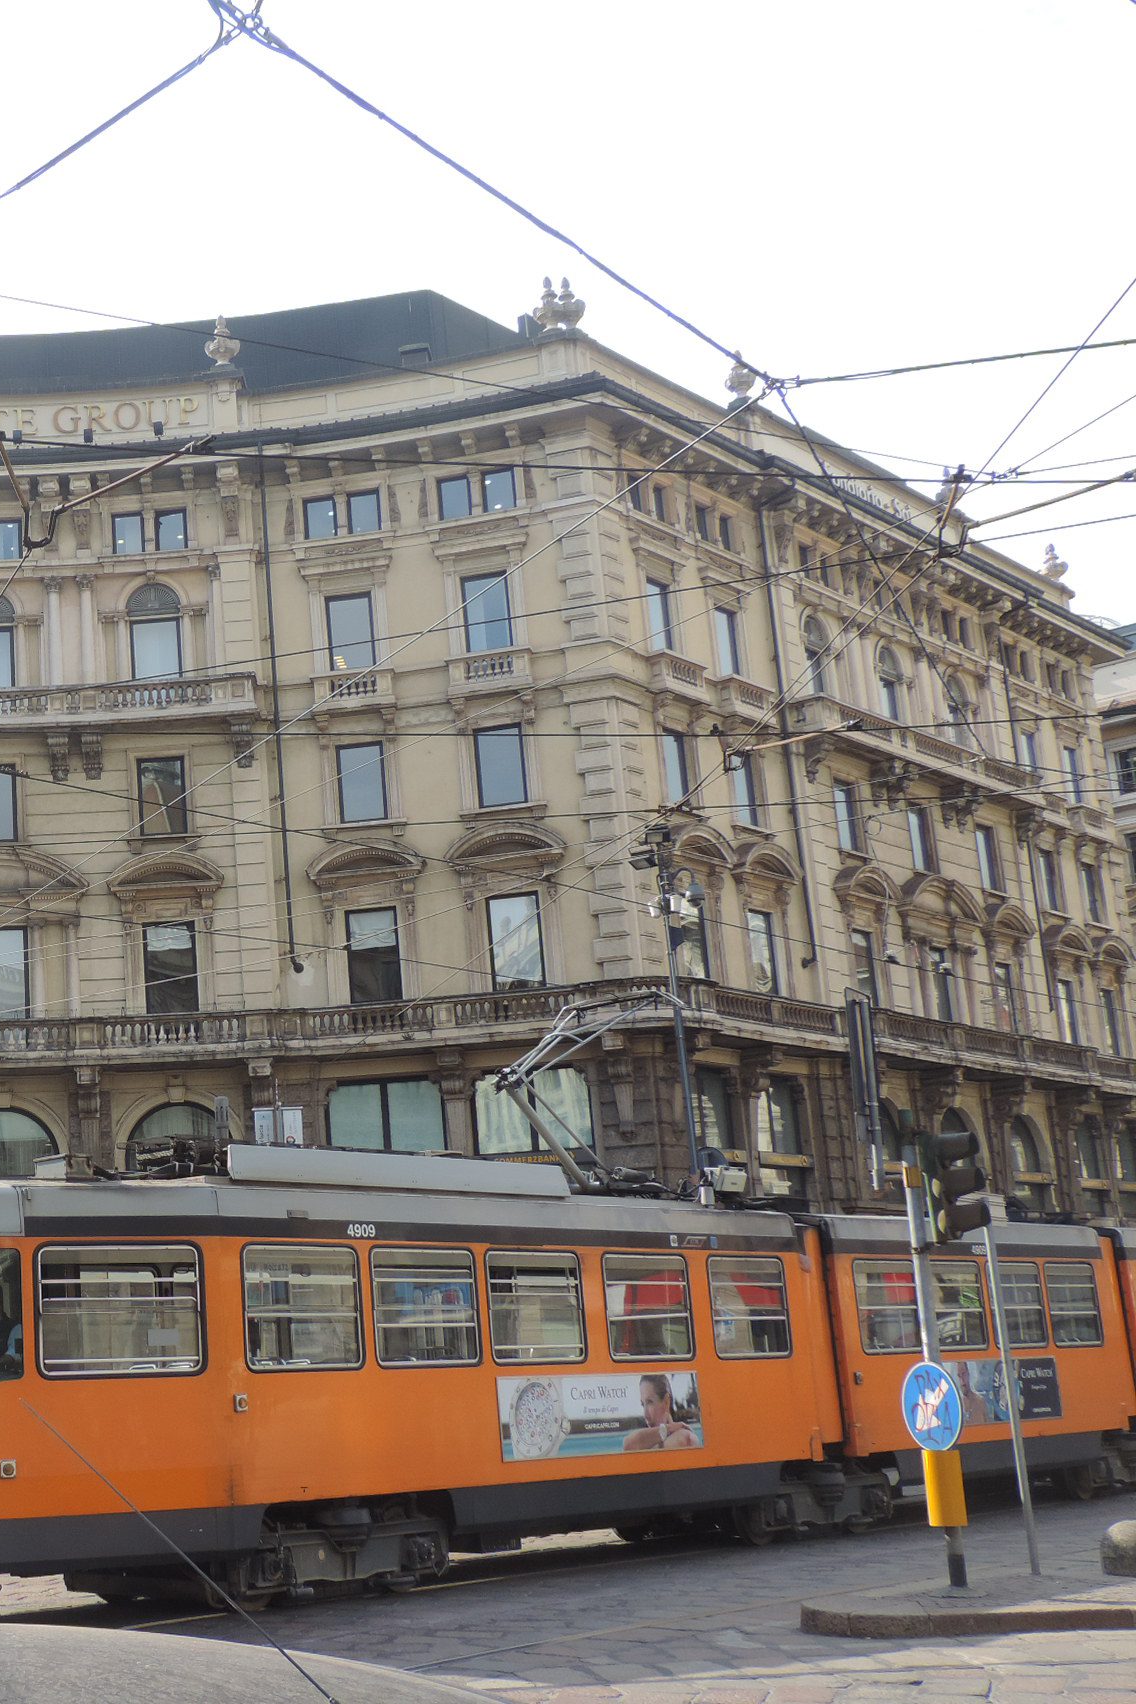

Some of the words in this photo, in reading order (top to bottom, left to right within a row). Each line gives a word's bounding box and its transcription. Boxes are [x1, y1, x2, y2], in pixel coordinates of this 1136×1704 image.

[52, 397, 200, 434] GROUP
[347, 1223, 376, 1237] 4909
[570, 1387, 596, 1401] CAPRI
[597, 1385, 627, 1399] WATCH
